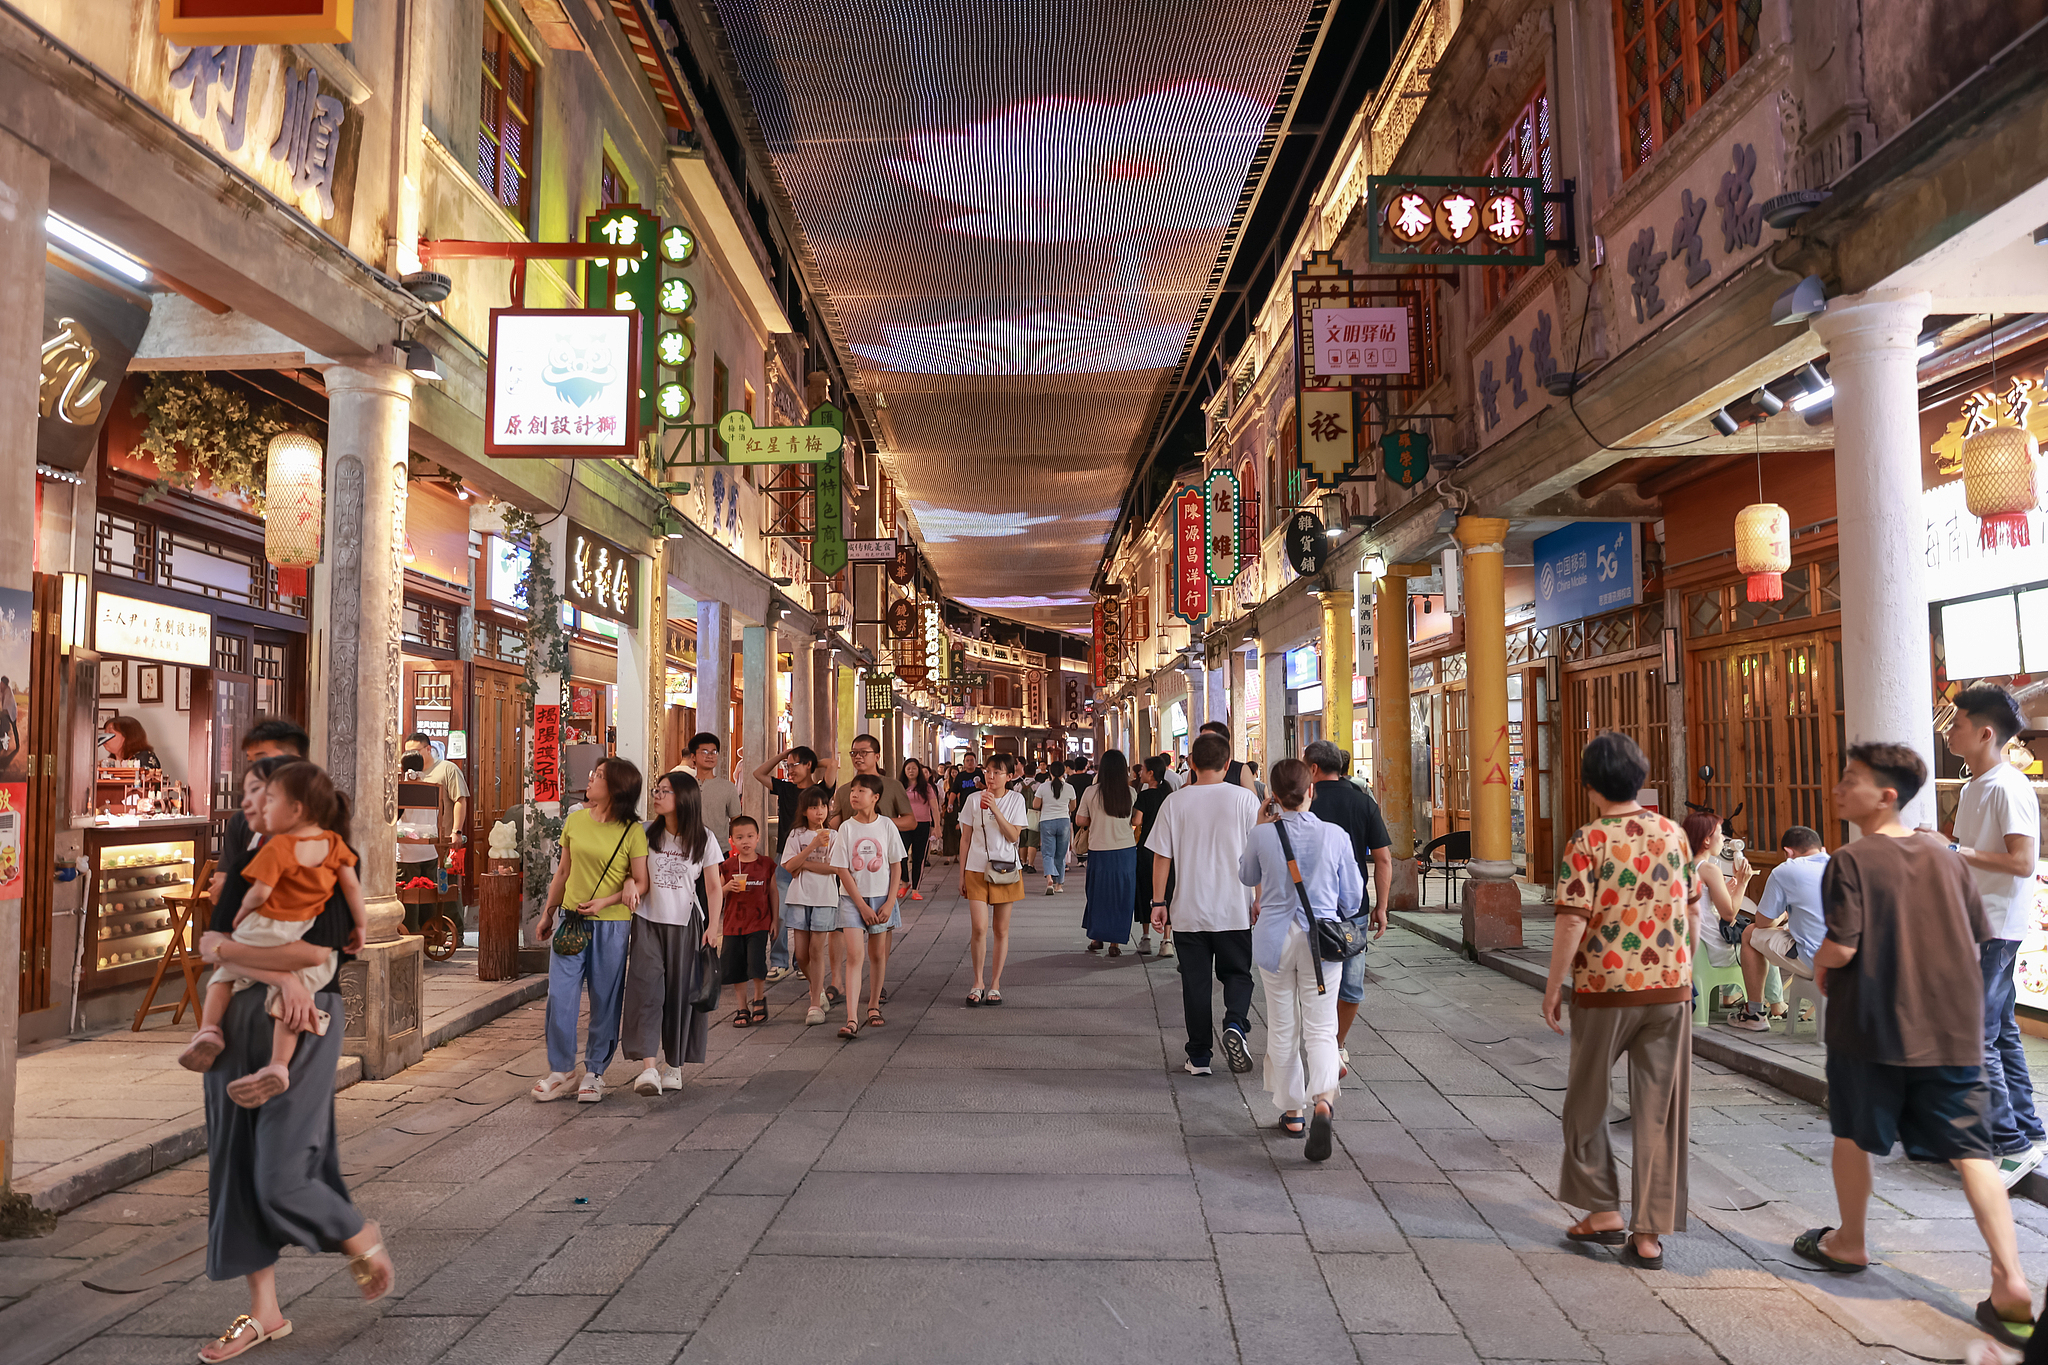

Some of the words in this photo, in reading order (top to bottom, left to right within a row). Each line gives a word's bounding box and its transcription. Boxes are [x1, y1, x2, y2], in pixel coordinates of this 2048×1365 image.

[1395, 194, 1524, 238] 茶事集
[1325, 323, 1396, 343] 文明驿站
[504, 414, 617, 436] 原創設計獅
[746, 434, 823, 454] 紅星青梅
[1211, 489, 1234, 560] 佐維
[1184, 502, 1202, 608] 陳源昌洋行
[1555, 549, 1588, 578] 中国移动
[1556, 580, 1571, 593] China
[1570, 572, 1588, 588] Mobile
[1360, 594, 1372, 652] 烟酒商行
